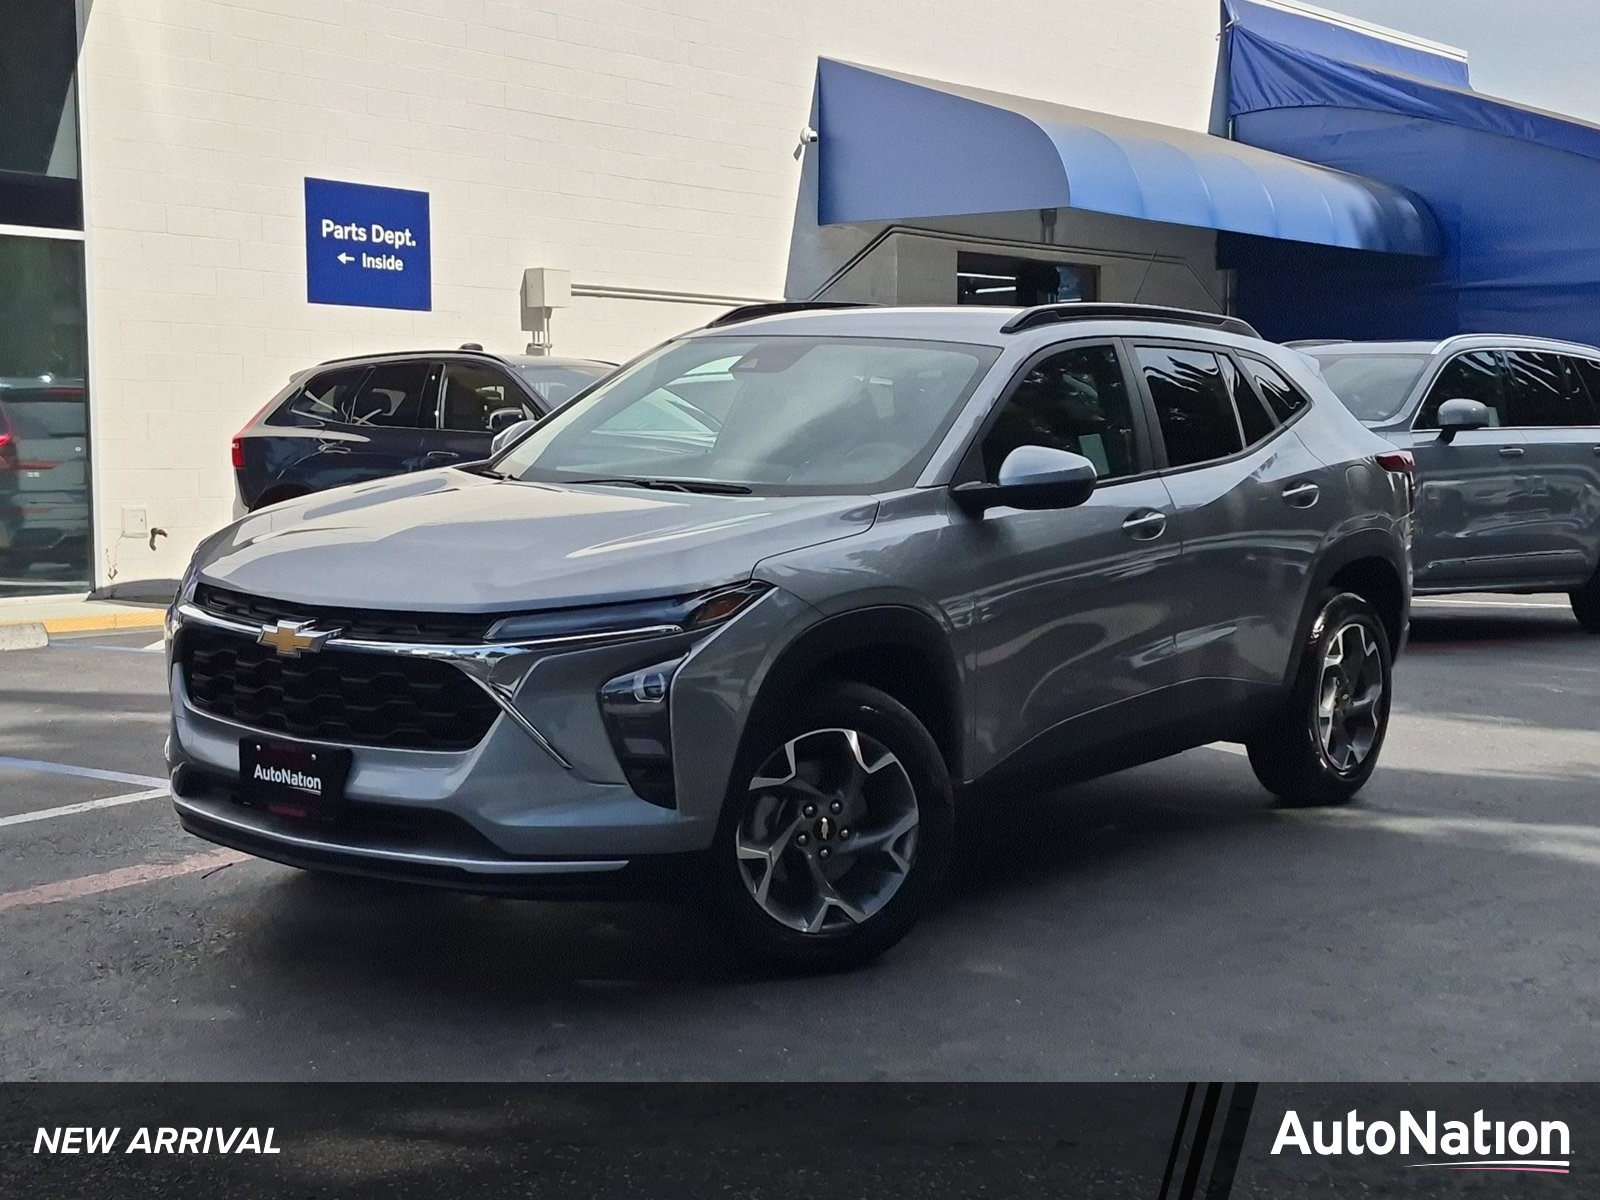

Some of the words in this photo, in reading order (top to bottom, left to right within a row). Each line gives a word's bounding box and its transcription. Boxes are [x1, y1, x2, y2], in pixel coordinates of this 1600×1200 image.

[321, 218, 367, 241] Parts
[371, 223, 417, 249] Dept.
[362, 252, 404, 271] Inside
[253, 763, 322, 791] AutoNation
